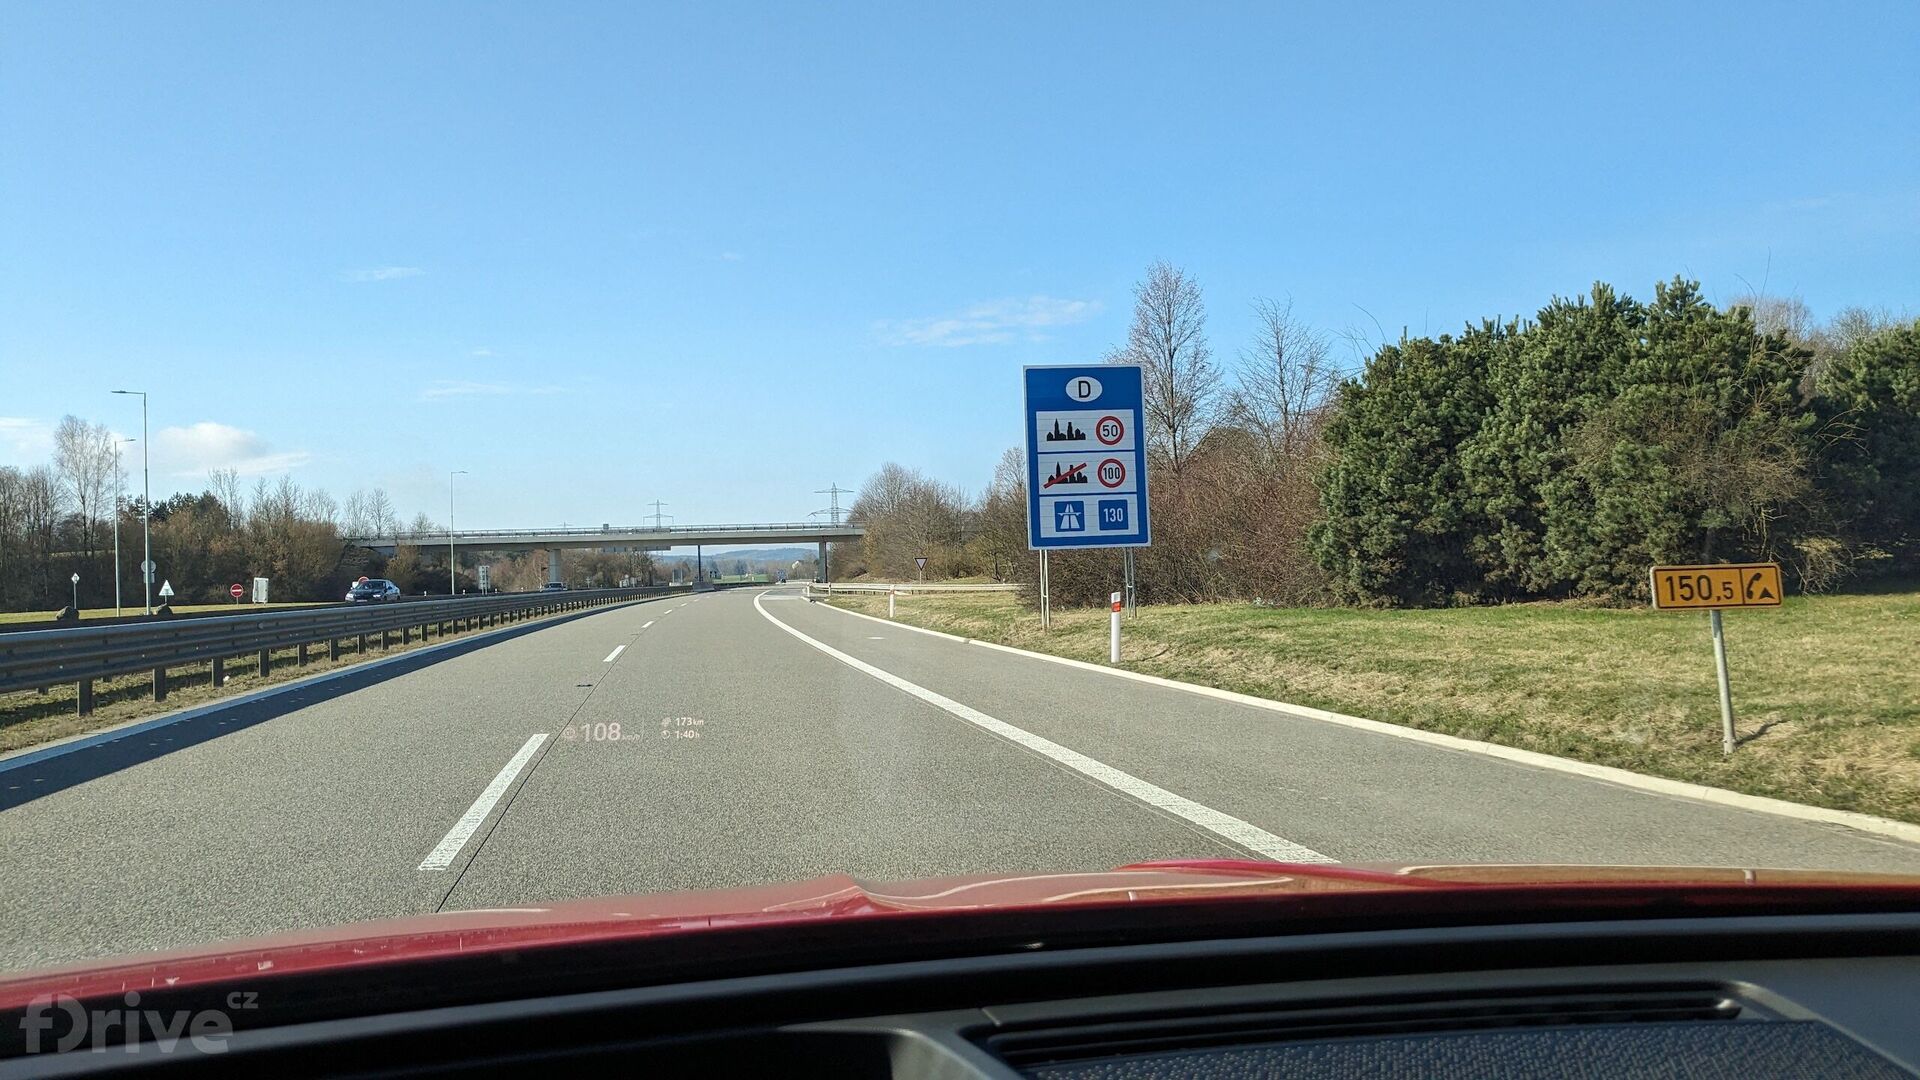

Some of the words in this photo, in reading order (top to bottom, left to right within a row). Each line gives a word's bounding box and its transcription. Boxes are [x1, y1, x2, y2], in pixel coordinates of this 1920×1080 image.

[1078, 380, 1091, 398] D
[1102, 424, 1118, 438] 50
[1103, 467, 1121, 480] 100
[1103, 507, 1124, 523] 130
[675, 717, 692, 726] 173
[581, 722, 621, 742] 108
[675, 730, 695, 738] 1:40
